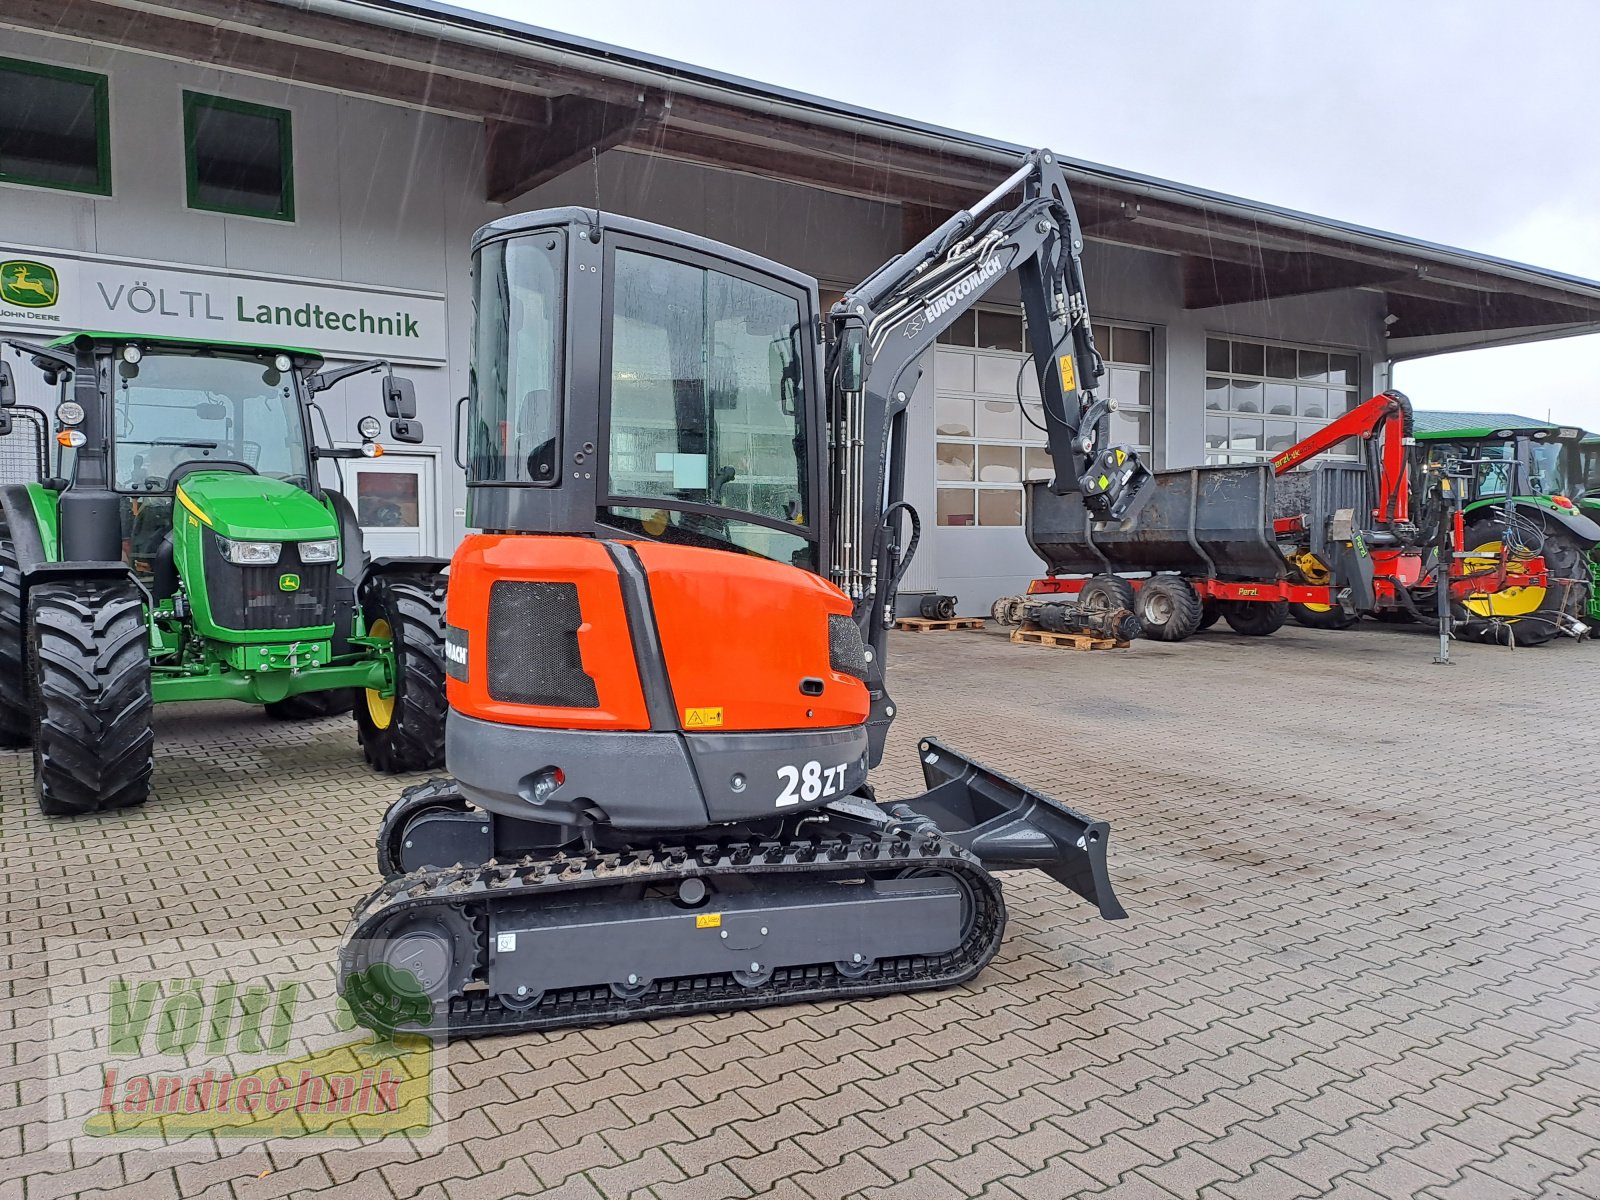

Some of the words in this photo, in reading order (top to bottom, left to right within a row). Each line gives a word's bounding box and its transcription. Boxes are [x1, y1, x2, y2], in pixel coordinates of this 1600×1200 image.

[27, 311, 61, 322] DEERE
[96, 280, 224, 321] VÖLTL
[237, 295, 419, 338] Landtechnik
[924, 256, 1002, 323] EUROCOMACH
